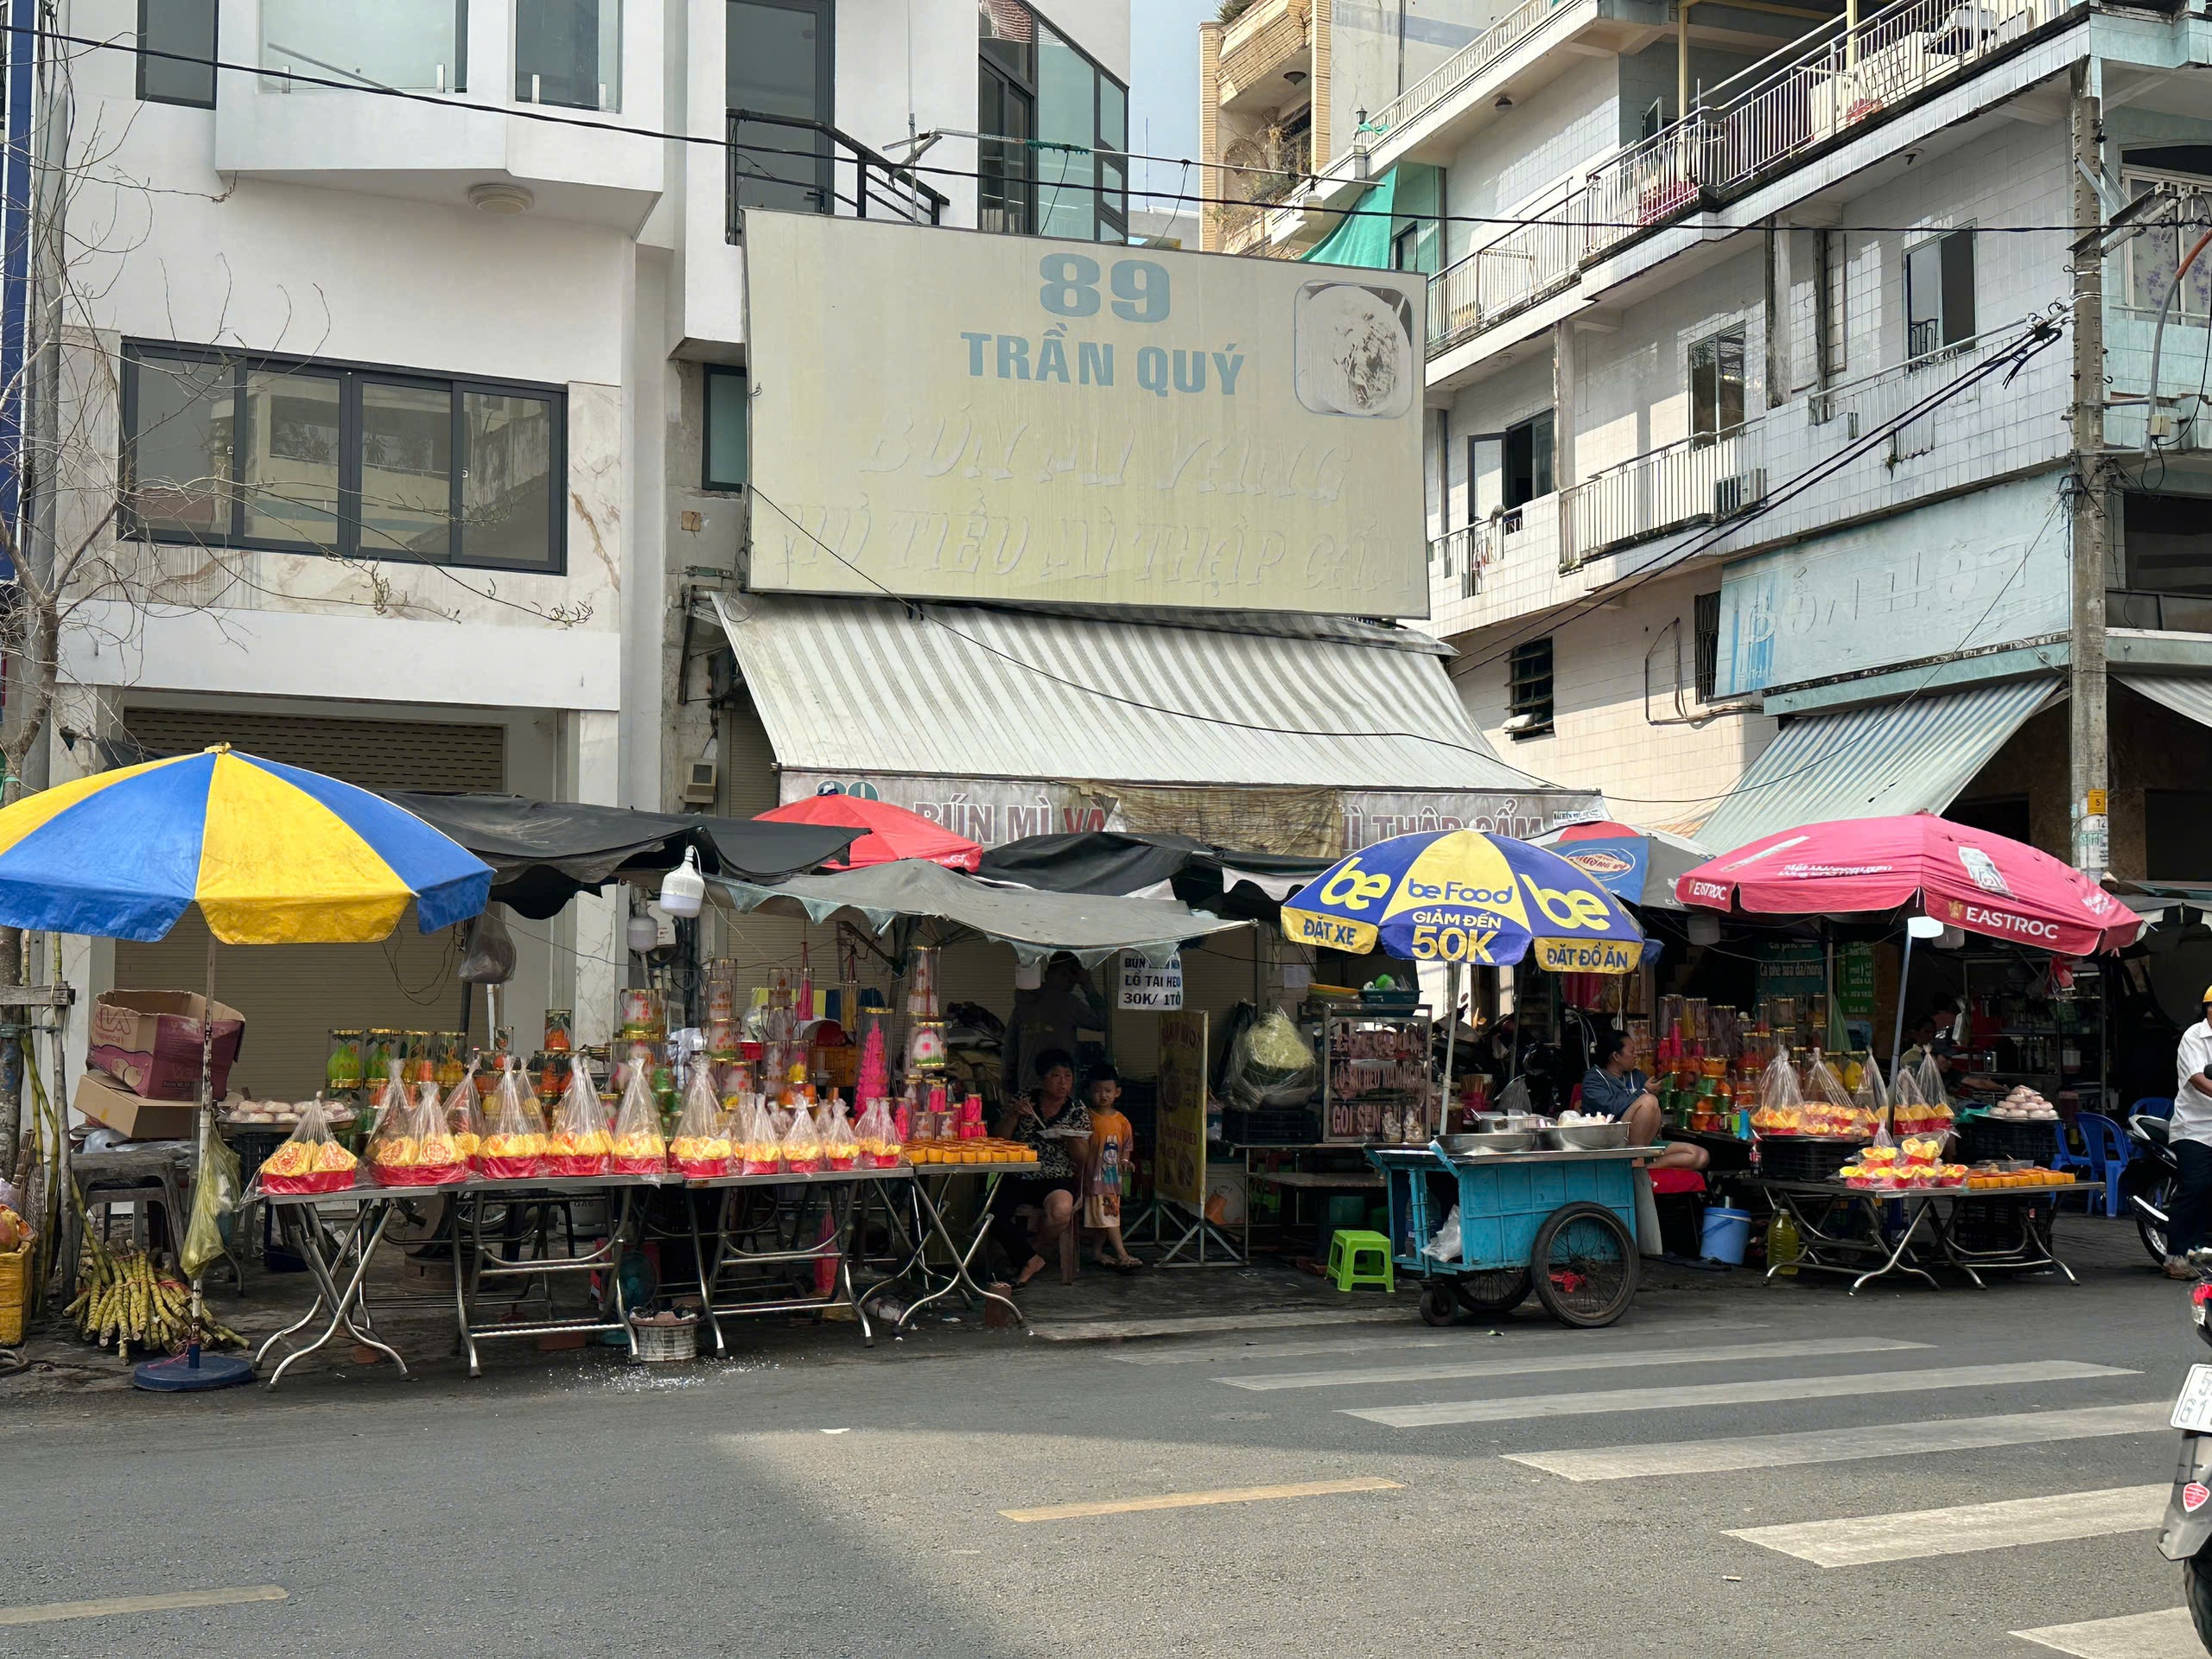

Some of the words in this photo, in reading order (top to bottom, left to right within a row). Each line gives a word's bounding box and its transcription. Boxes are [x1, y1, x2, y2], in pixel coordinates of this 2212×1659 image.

[1039, 253, 1170, 323] 89
[960, 322, 1114, 387] TRẦN
[1137, 343, 1244, 397] QUÝ
[1006, 796, 1054, 844] MÌ
[1342, 805, 1364, 851] Ì
[1319, 857, 1391, 910] be
[1412, 907, 1460, 926] GIẢM
[1463, 909, 1502, 929] ĐẾN
[1519, 874, 1611, 931] be
[1303, 915, 1332, 944] ĐẶT
[1334, 925, 1357, 947] XE
[1966, 906, 2059, 940] EASTROC
[1411, 926, 1498, 963] 50K
[1547, 944, 1577, 968] ĐẶT
[1579, 941, 1601, 967] ĐỒ
[1604, 944, 1628, 968] ĂN
[1123, 993, 1158, 1005] 30K/
[1145, 976, 1163, 987] TAI
[1166, 976, 1181, 988] HEO
